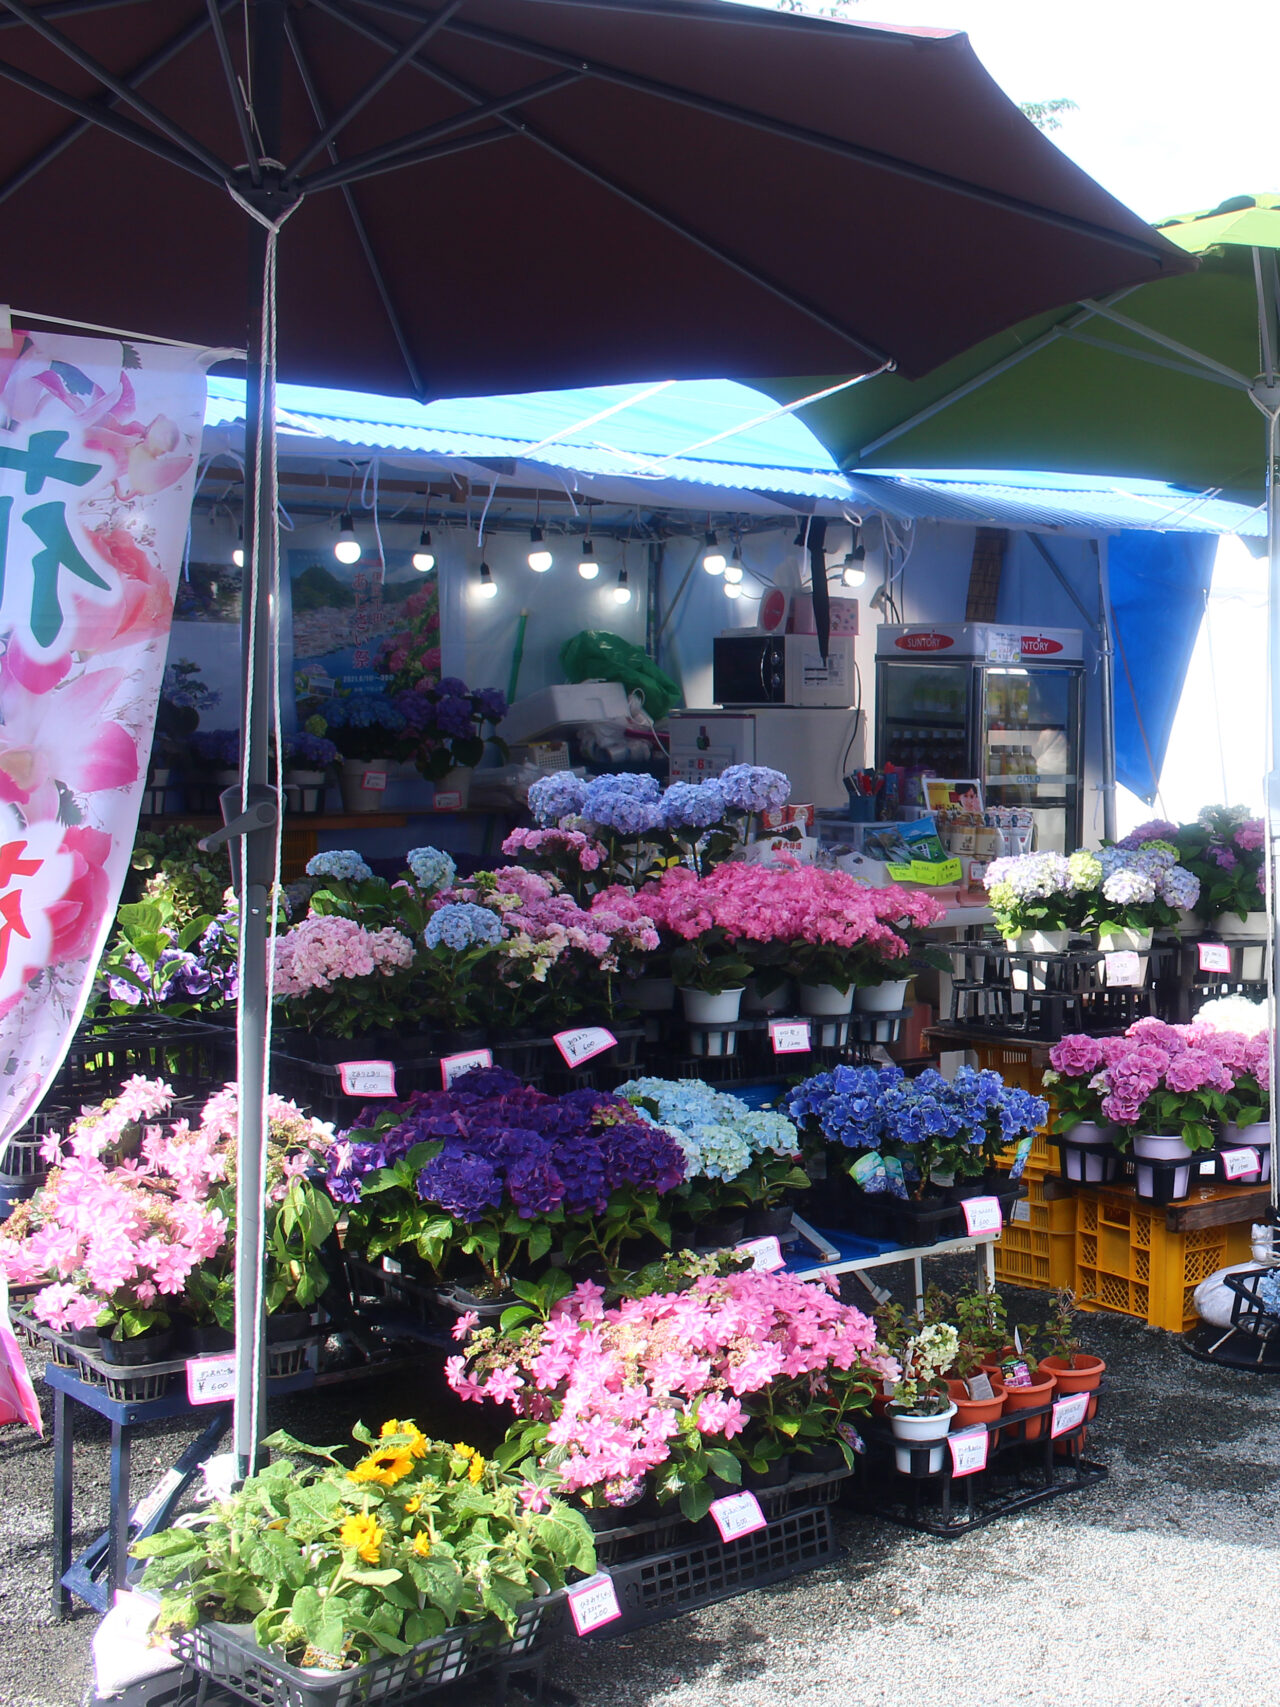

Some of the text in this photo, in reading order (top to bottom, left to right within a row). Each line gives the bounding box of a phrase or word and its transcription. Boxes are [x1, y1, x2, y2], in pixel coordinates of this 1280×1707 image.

[352, 571, 370, 669] あじさい祭
[907, 635, 942, 648] SUNTORY
[1022, 639, 1050, 652] NTORY
[1016, 775, 1041, 784] COLD
[211, 1382, 229, 1391] 600
